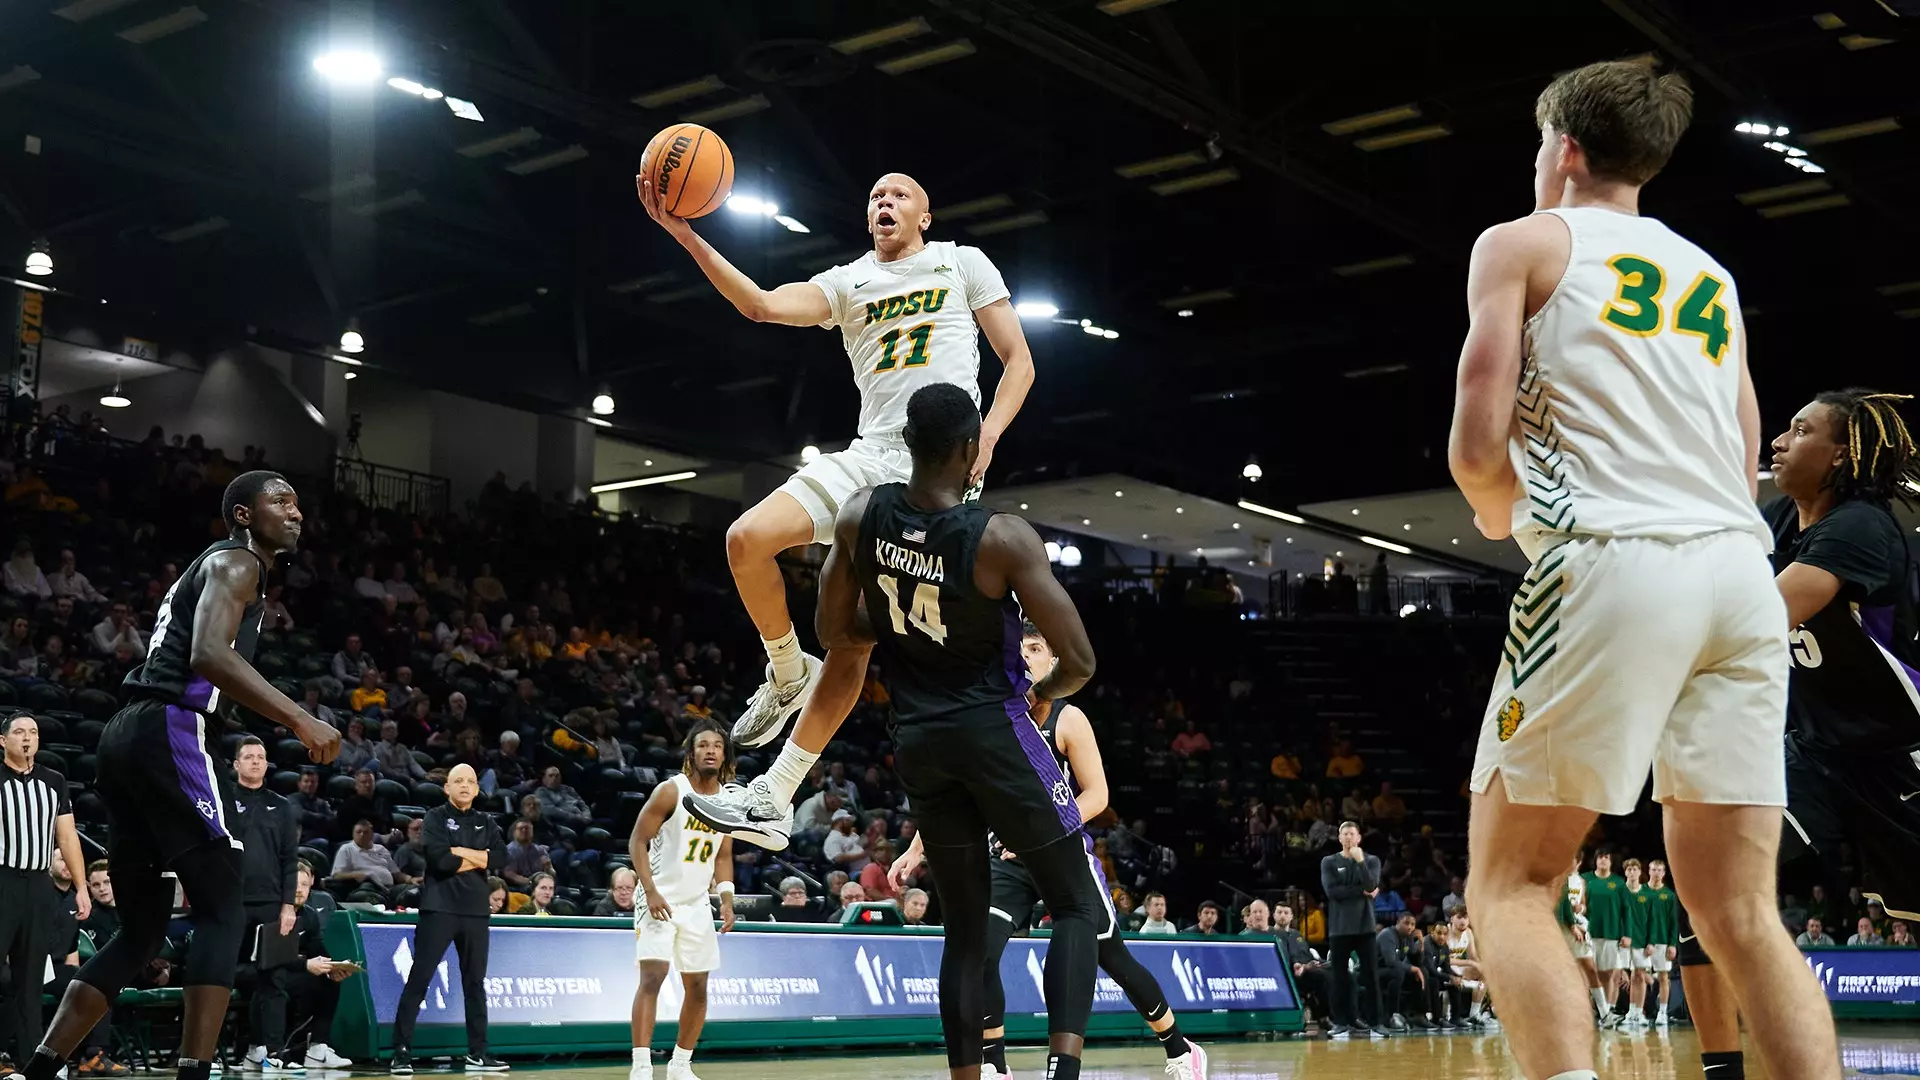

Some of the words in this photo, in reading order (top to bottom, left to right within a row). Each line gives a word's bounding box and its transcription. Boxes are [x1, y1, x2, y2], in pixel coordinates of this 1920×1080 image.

[659, 136, 692, 195] Wilson
[864, 287, 950, 326] NDSU
[1598, 253, 1732, 367] 34
[873, 322, 935, 374] 11
[876, 538, 944, 582] KOROMA
[877, 574, 948, 646] 14
[684, 837, 714, 864] 10
[483, 977, 513, 995] RST
[516, 977, 602, 995] WESTERN
[706, 977, 748, 994] FIRST
[749, 977, 820, 995] WESTERN
[902, 977, 940, 993] FIRST
[1207, 977, 1234, 991] FIRST
[1234, 977, 1278, 991] WESTERN
[1838, 975, 1875, 987] FIRST
[1876, 975, 1920, 987] WESTE
[1838, 986, 1861, 994] BANK
[1871, 985, 1899, 994] TRUST
[504, 996, 513, 1008] &
[514, 996, 554, 1008] TRUST
[709, 994, 739, 1006] BANK
[740, 994, 748, 1006] &
[748, 994, 781, 1006] TRUST
[906, 993, 932, 1004] BANK
[1099, 991, 1123, 1002] TRUST
[1235, 991, 1256, 1001] TRUST
